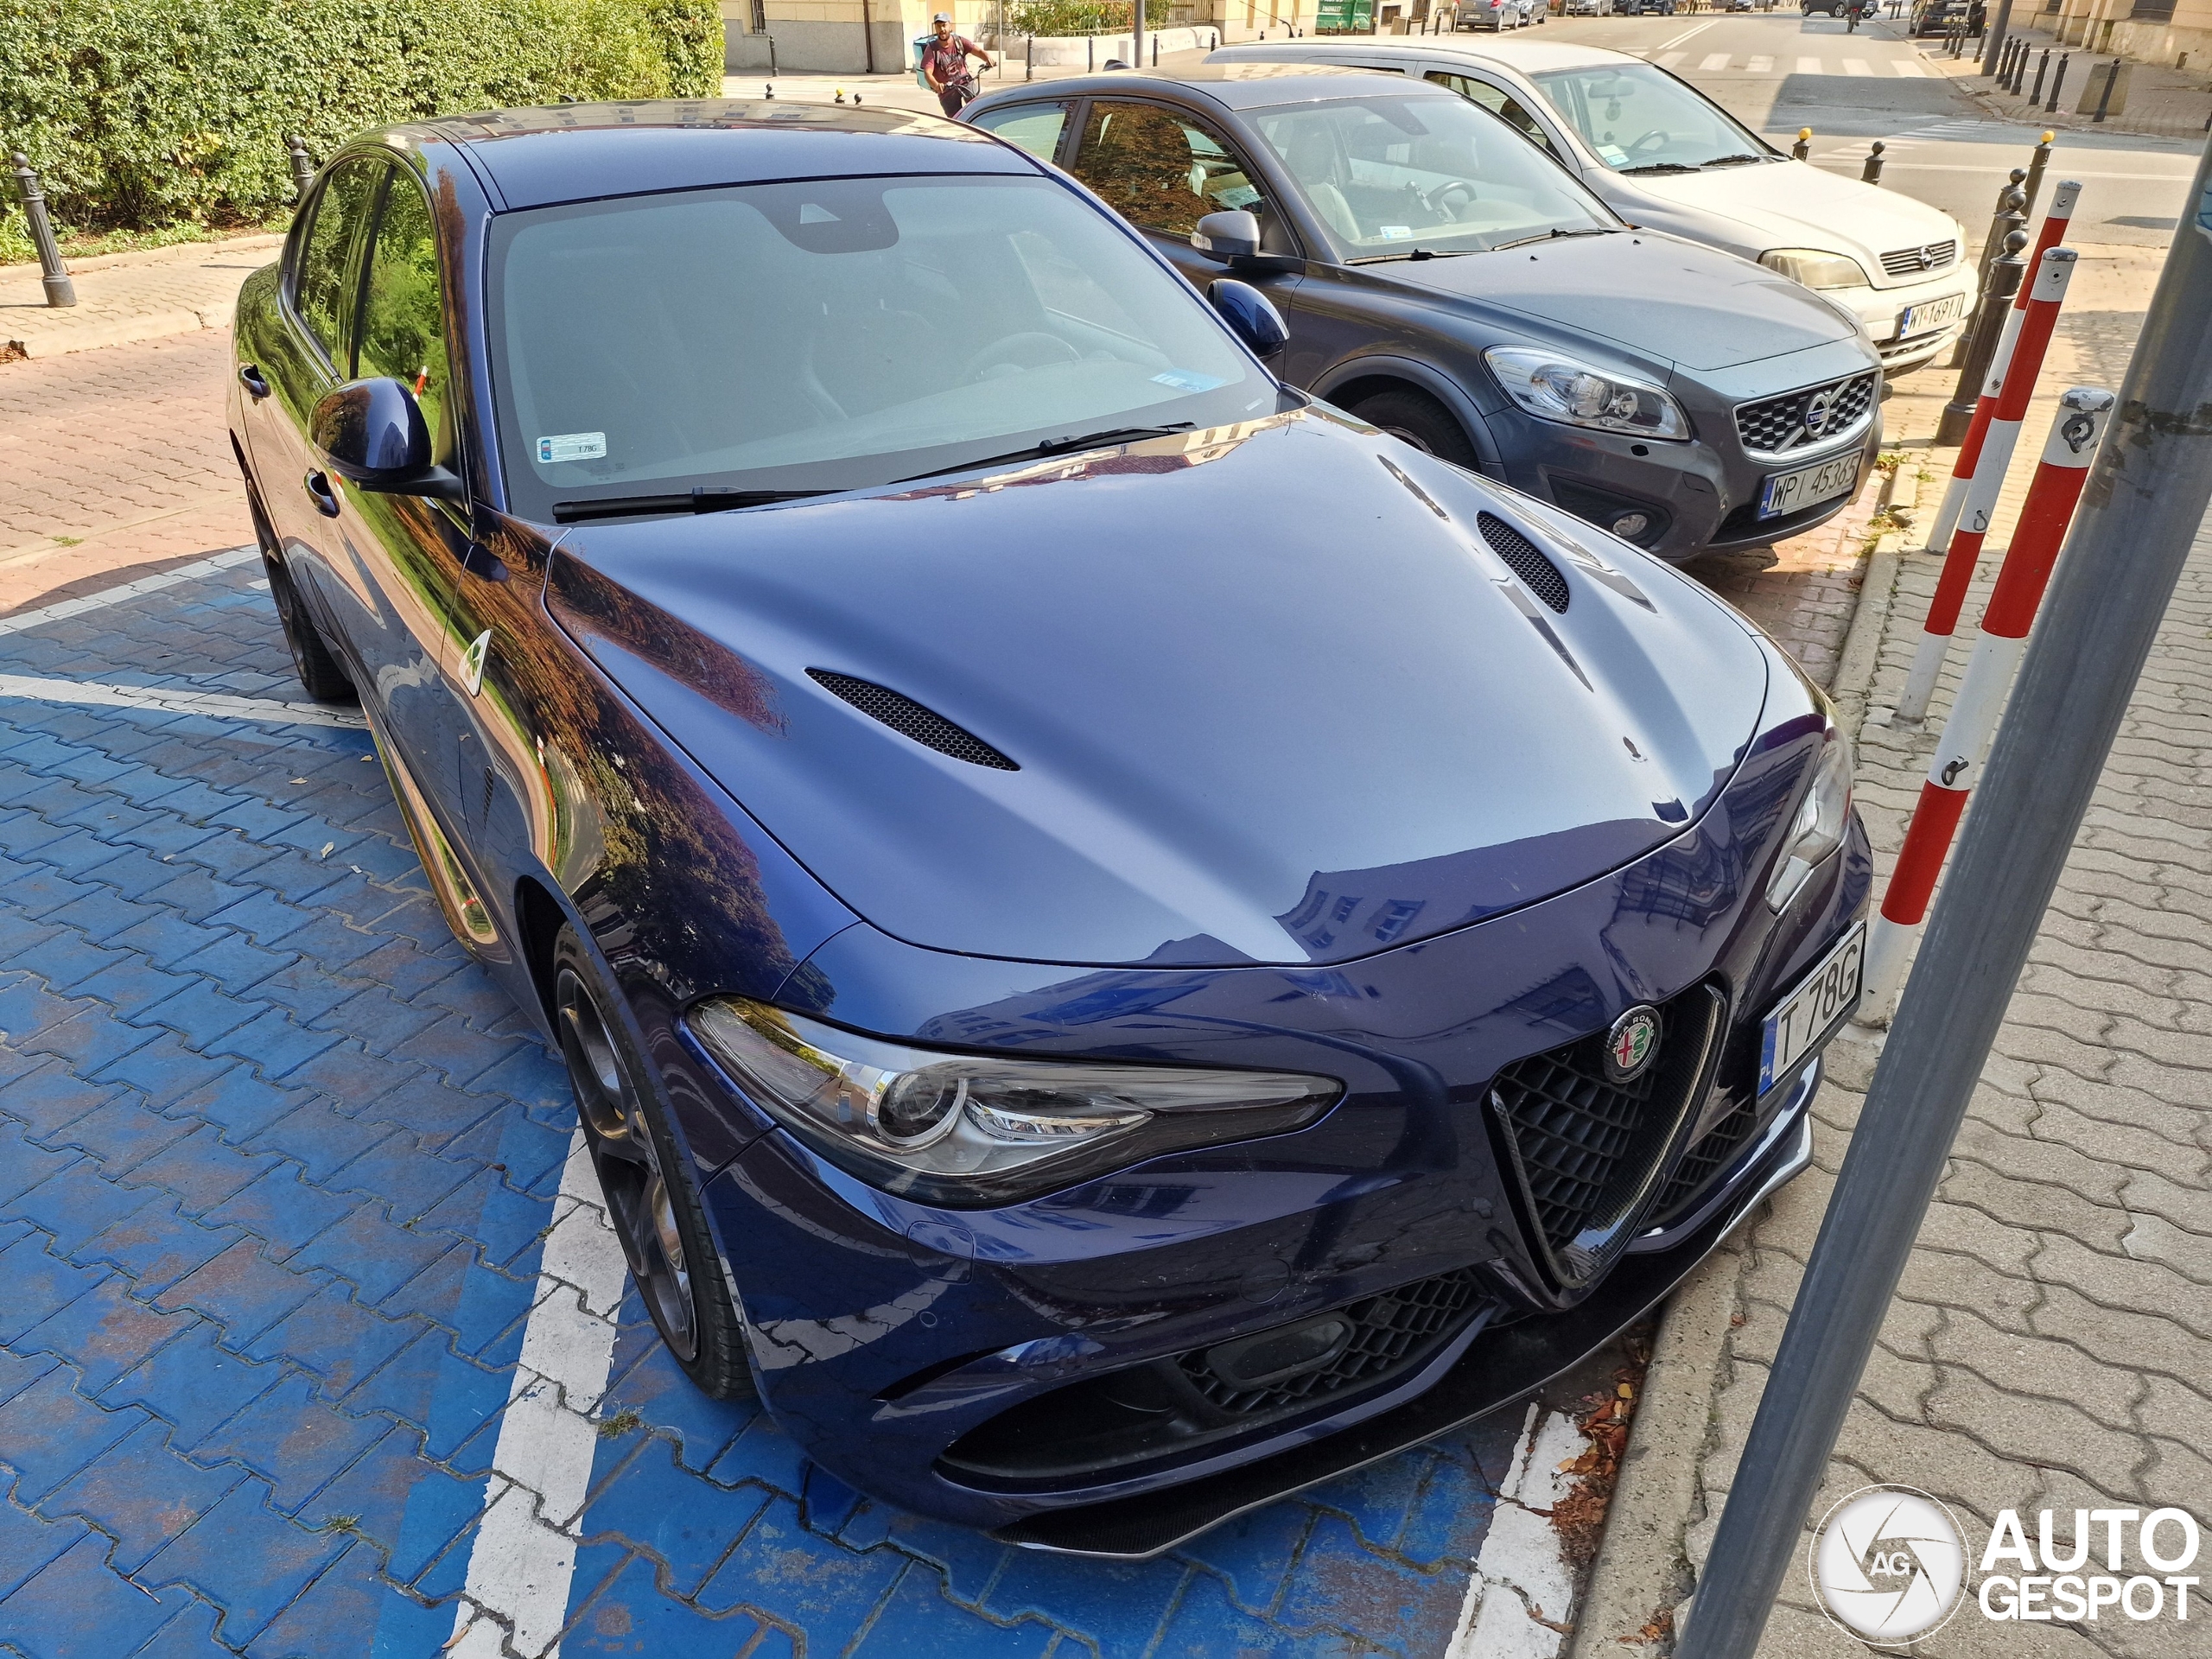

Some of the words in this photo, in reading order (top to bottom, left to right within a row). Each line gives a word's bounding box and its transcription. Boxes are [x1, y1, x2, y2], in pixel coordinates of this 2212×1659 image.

[1909, 306, 1927, 330] WY
[1928, 296, 1961, 324] 1691J
[583, 444, 597, 453] 78G
[1810, 455, 1859, 495] 45365
[1760, 501, 1769, 510] PL
[1781, 1001, 1799, 1065] T
[1805, 944, 1858, 1043] 78G
[1632, 1015, 1656, 1037] ROMEO
[1759, 1063, 1772, 1084] PL
